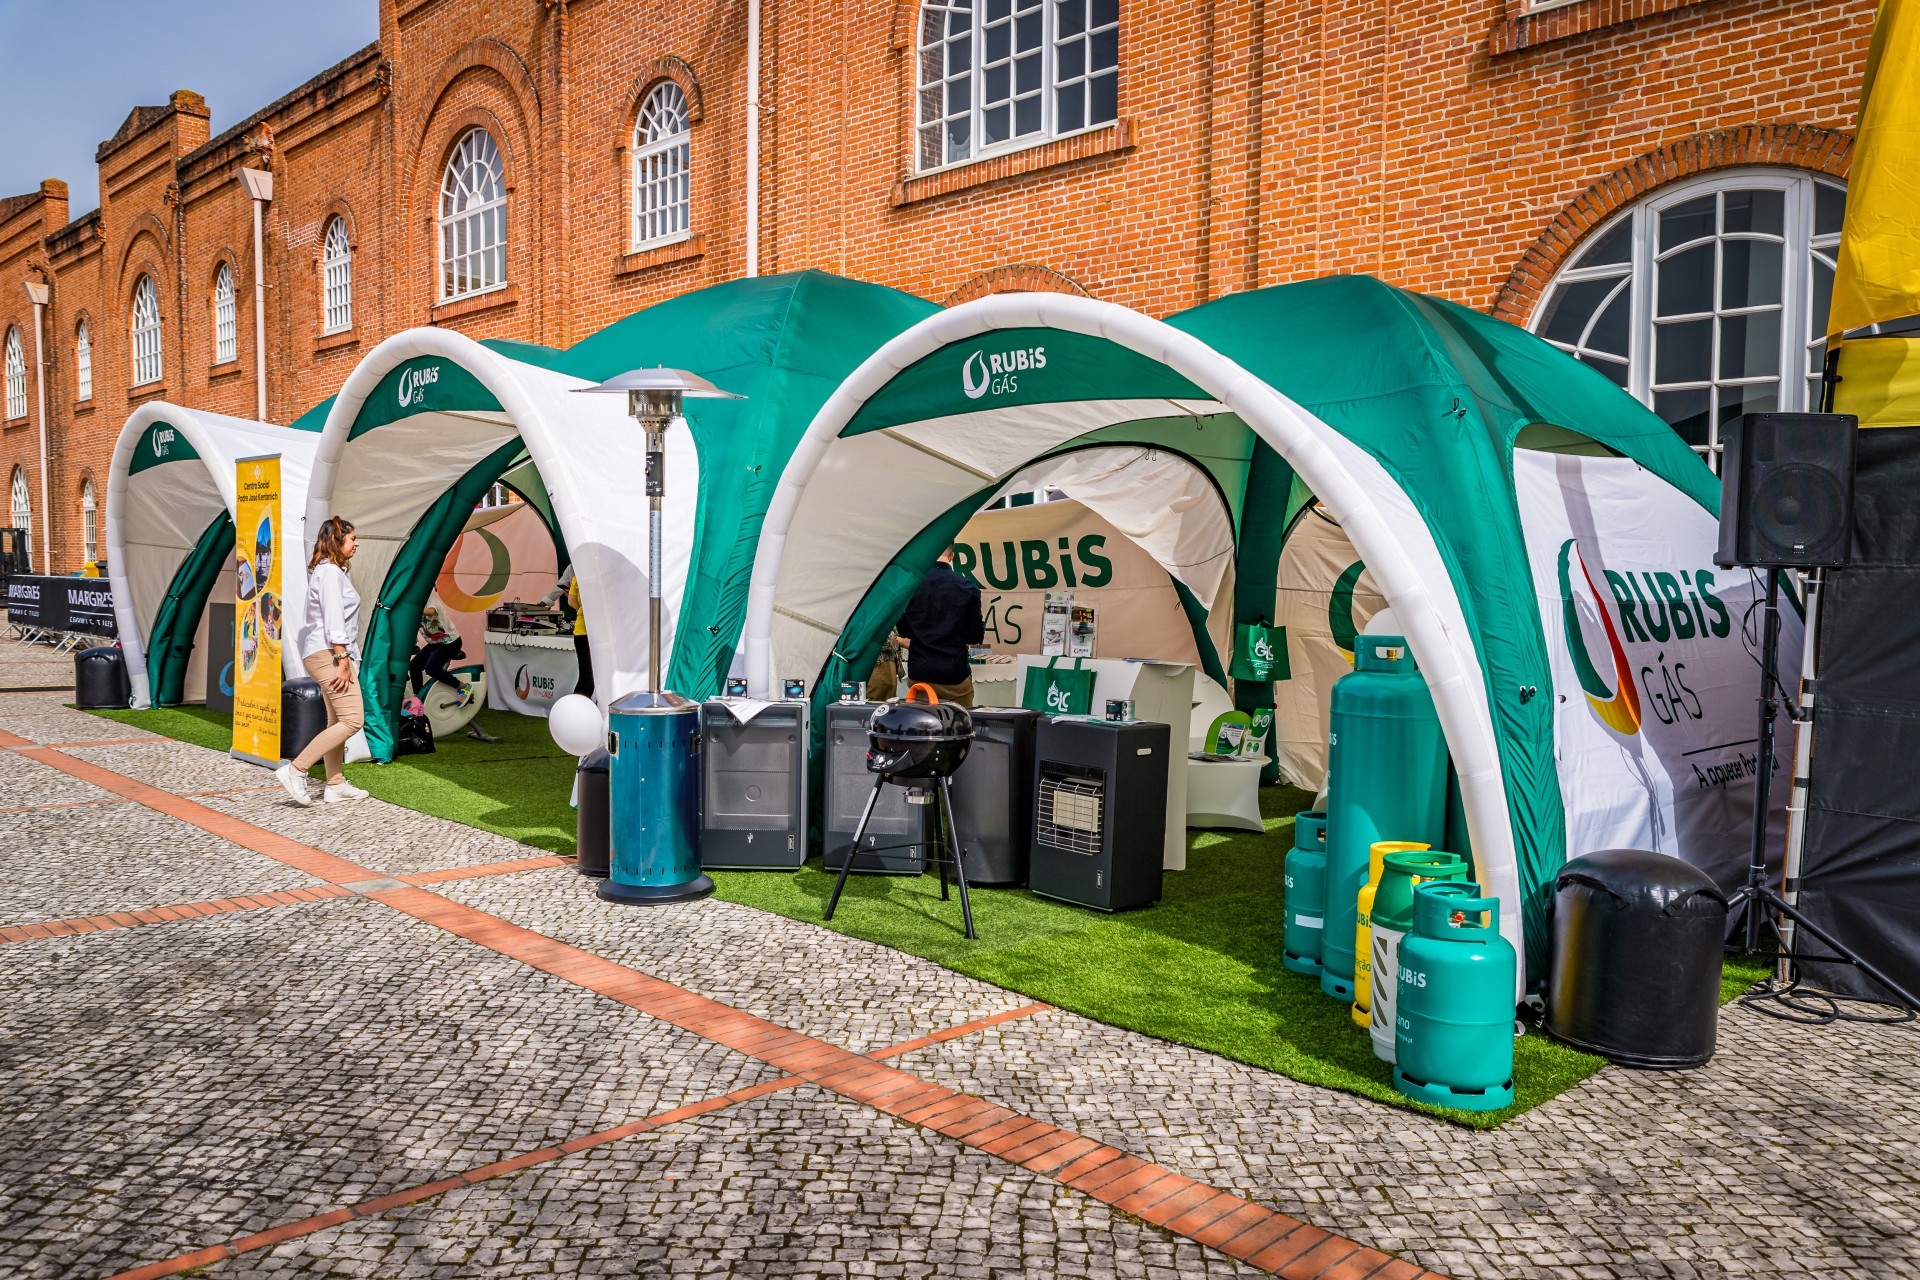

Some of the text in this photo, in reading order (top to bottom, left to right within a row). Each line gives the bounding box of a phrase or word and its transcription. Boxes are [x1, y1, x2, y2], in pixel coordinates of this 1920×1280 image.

[989, 346, 1047, 374] RUBiS
[413, 366, 440, 387] RUBiS
[991, 373, 1018, 395] GÁS
[412, 387, 424, 404] GÁS
[258, 480, 270, 489] Social
[953, 534, 1113, 590] RUBiS
[8, 584, 40, 600] MARGRES
[67, 589, 114, 608] MARGRES
[1602, 569, 1731, 643] RUBiS
[983, 596, 1023, 645] ÁS
[532, 675, 555, 691] RUBiS
[1641, 650, 1703, 725] GÁS
[1692, 763, 1710, 789] A
[1706, 760, 1745, 790] aquecer
